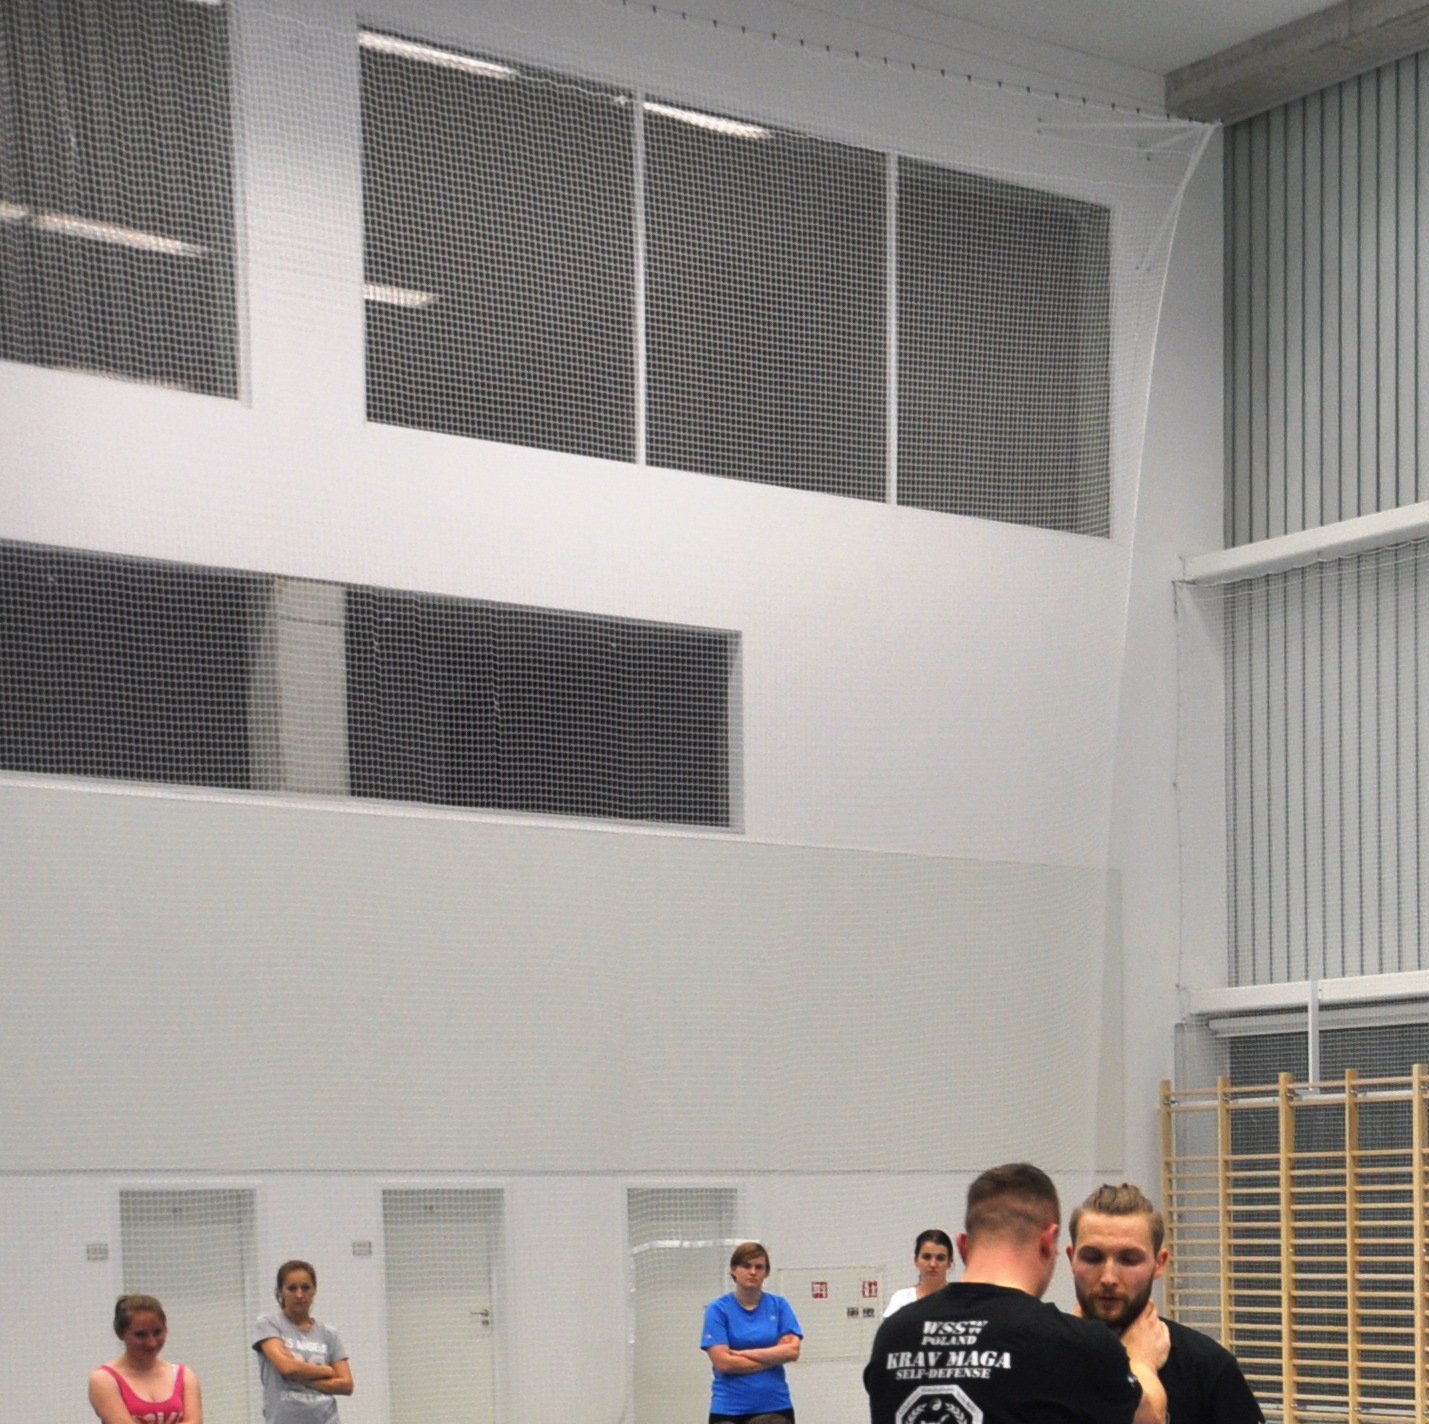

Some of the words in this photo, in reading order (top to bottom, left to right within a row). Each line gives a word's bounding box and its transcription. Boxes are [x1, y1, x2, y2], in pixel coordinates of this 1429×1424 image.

[923, 1320, 989, 1335] WSSW
[921, 1335, 978, 1346] POLAND
[886, 1351, 943, 1370] KRAV
[945, 1350, 1012, 1369] MAGA
[896, 1368, 992, 1380] SELF-DEFENSE
